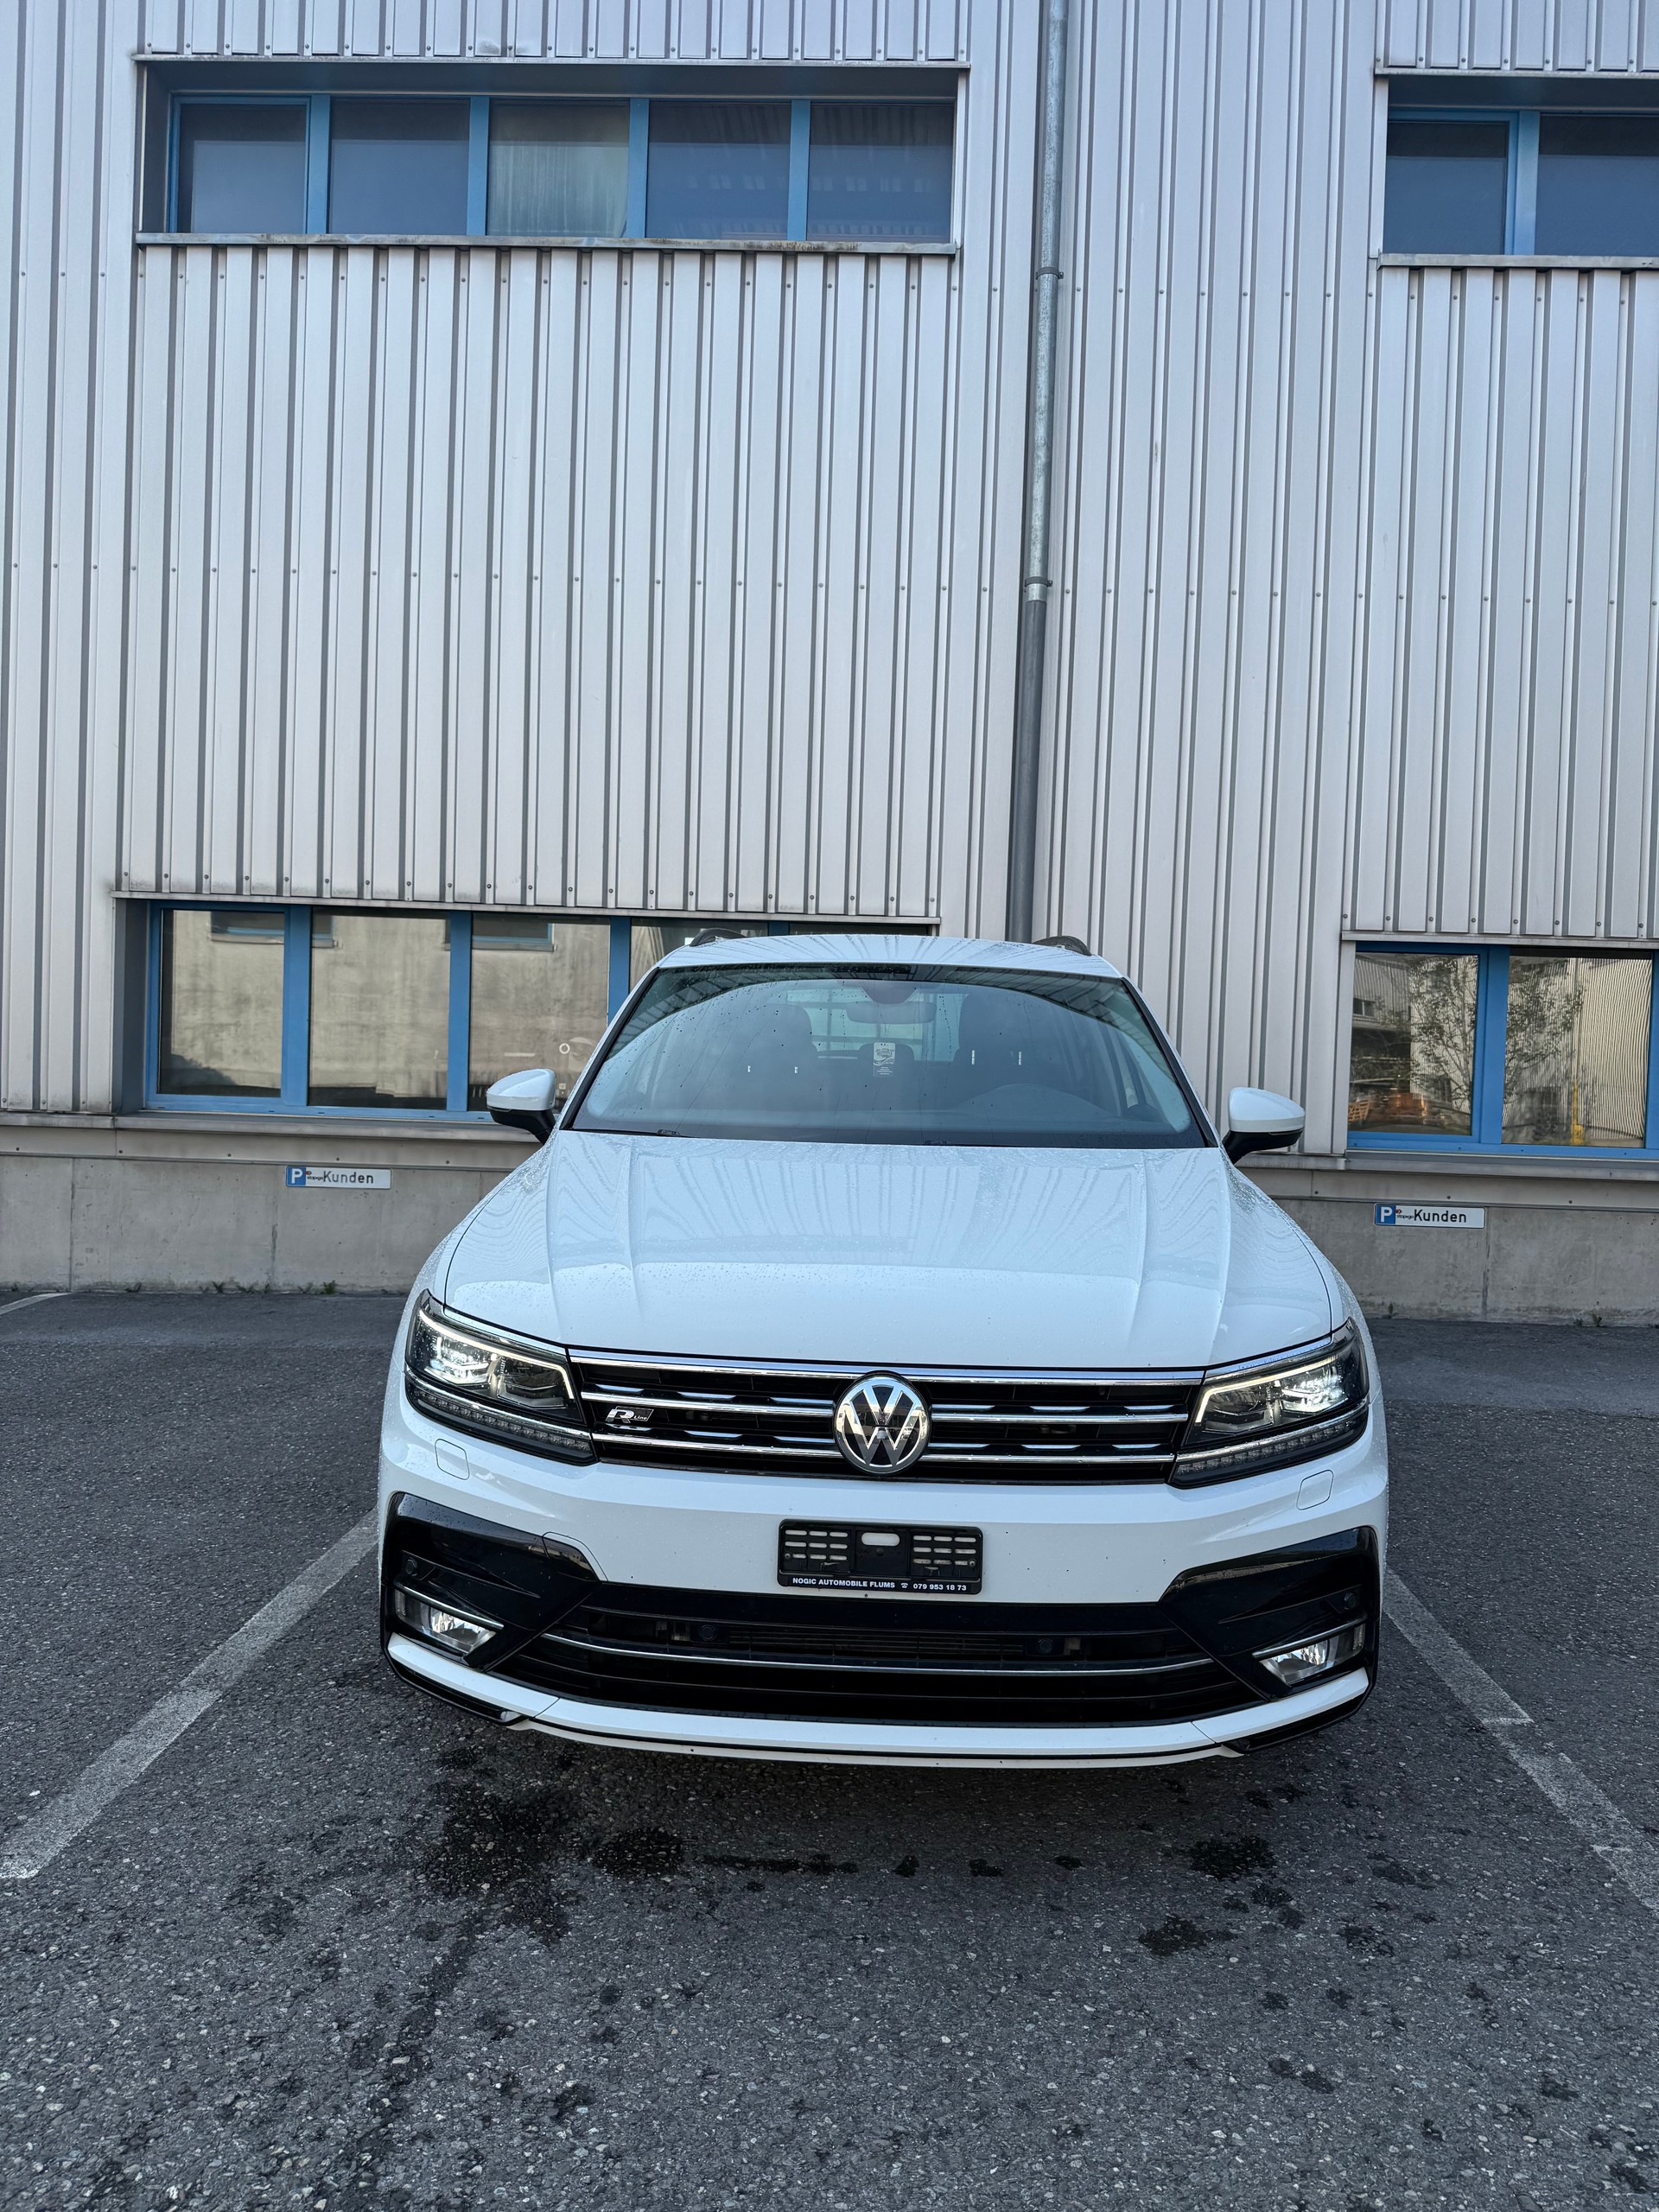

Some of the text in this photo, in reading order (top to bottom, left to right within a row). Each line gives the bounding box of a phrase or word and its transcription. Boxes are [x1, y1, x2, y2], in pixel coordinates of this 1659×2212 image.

[291, 1168, 303, 1184] P
[323, 1171, 374, 1184] Kunden
[1380, 1206, 1393, 1223] P
[1414, 1209, 1467, 1223] Kunden
[605, 1408, 635, 1424] R
[836, 1376, 928, 1473] VW
[817, 1579, 868, 1587] AUTOMOBILE
